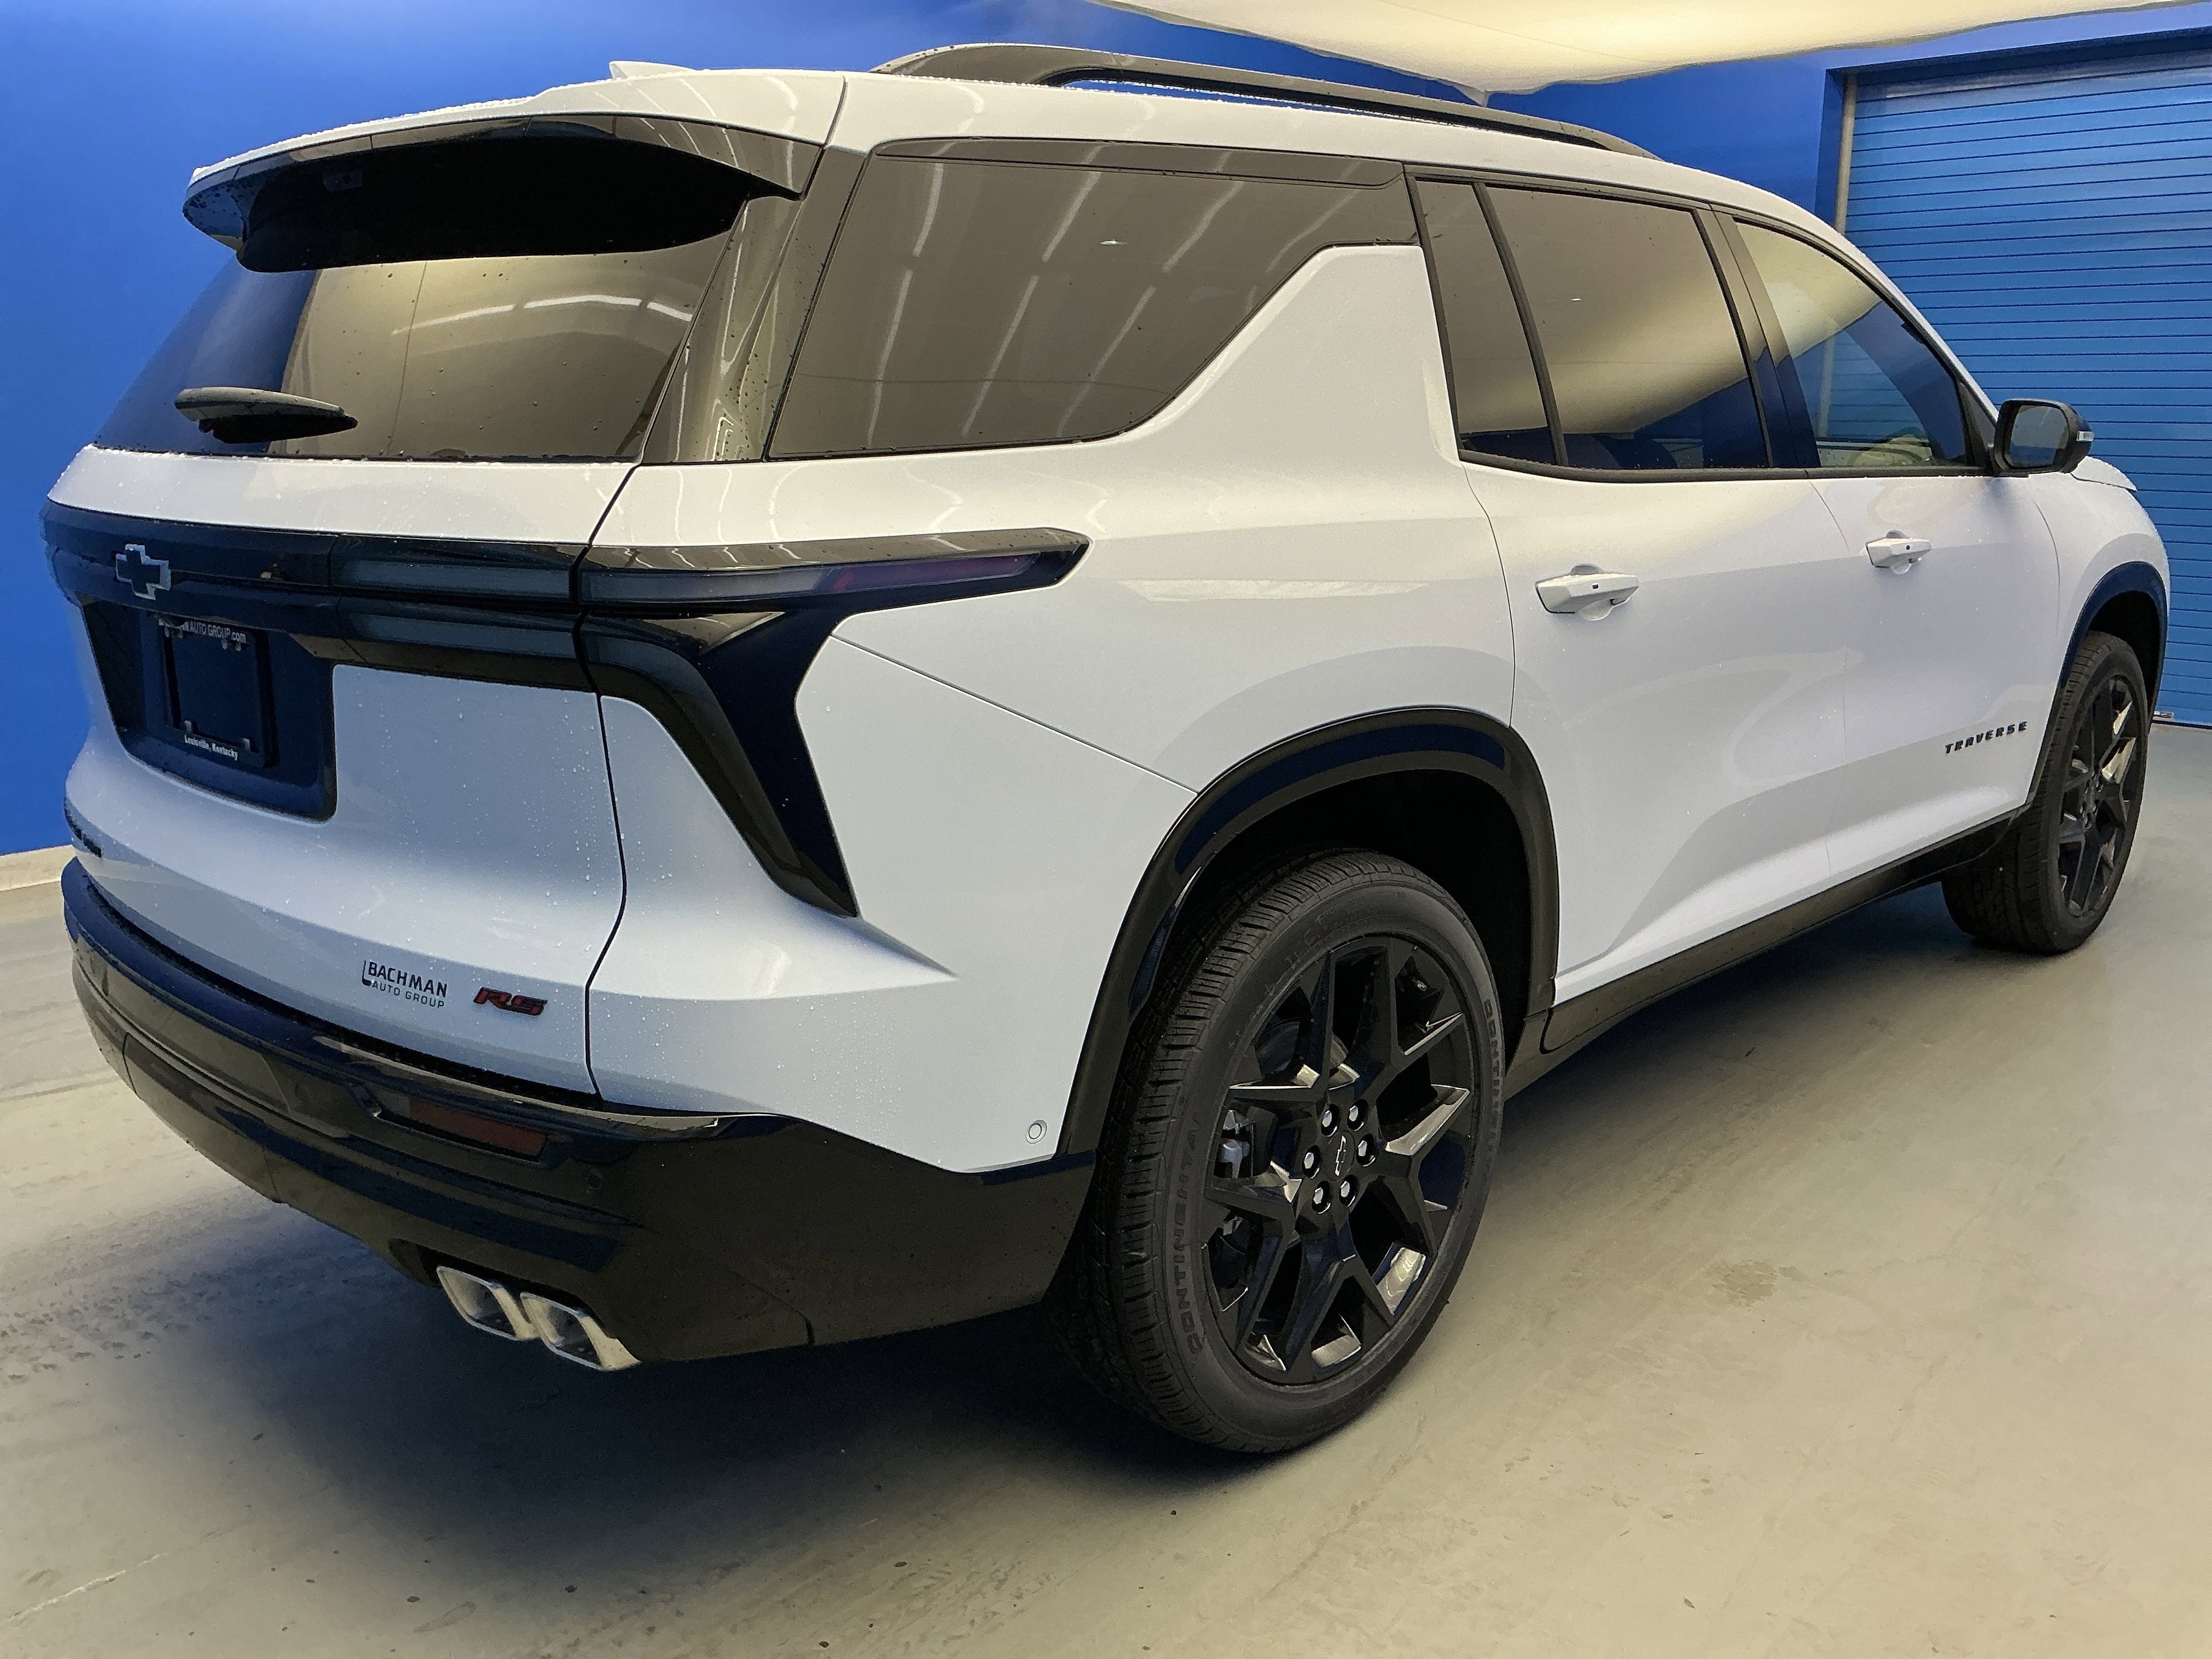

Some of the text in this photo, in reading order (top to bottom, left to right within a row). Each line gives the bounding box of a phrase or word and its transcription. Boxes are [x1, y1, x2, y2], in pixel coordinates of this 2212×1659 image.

[212, 742, 238, 761] Kentucky
[1945, 721, 2028, 754] TRAVERSE
[368, 961, 448, 998] BACHMAN
[372, 980, 445, 1009] AUTO GROUP
[473, 986, 548, 1016] RS
